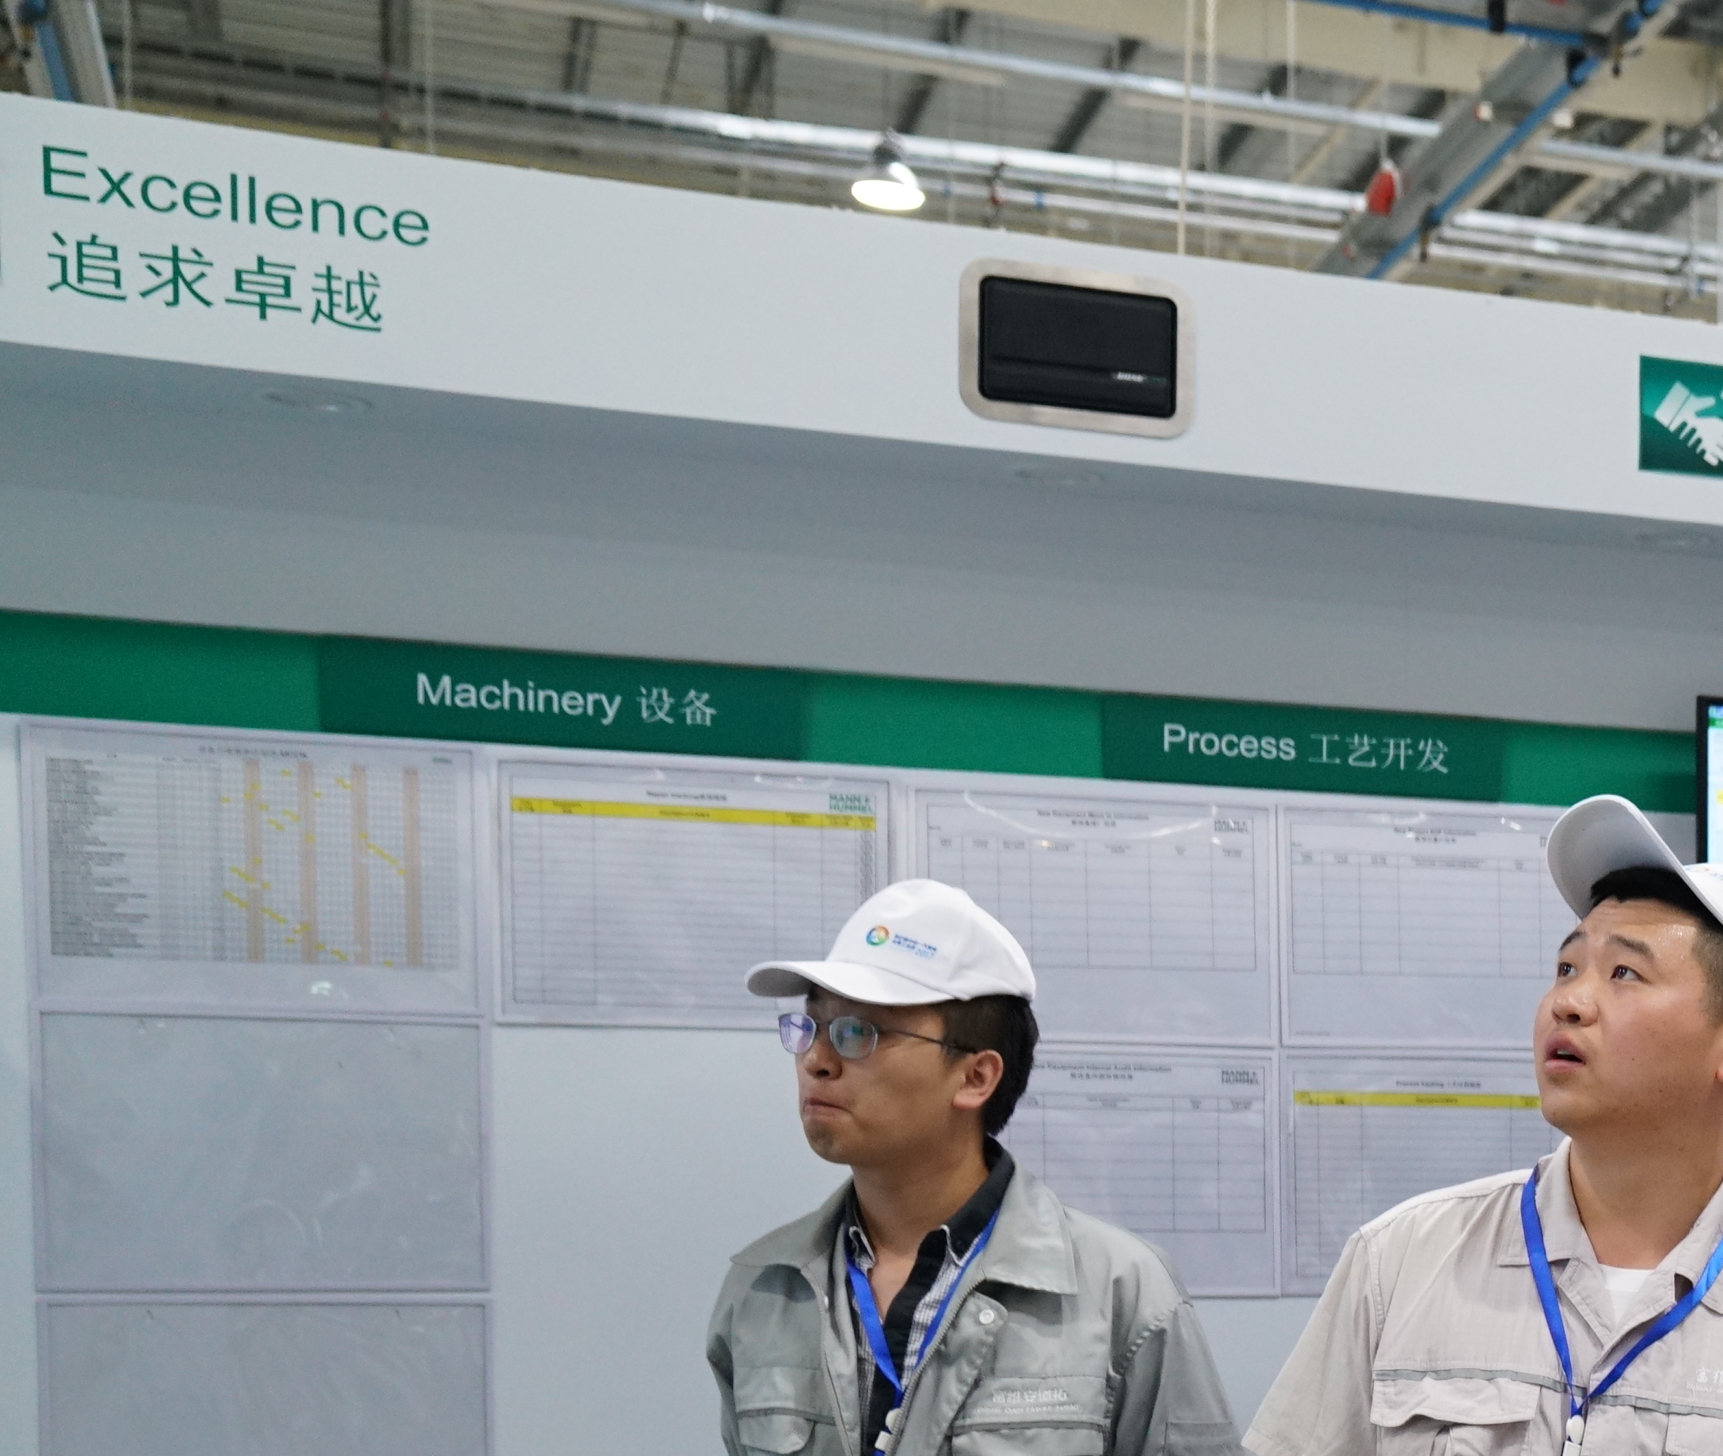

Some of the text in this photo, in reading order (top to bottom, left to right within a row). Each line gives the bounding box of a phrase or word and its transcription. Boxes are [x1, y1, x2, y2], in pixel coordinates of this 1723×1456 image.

[42, 144, 431, 248] Excellence
[46, 231, 384, 334] 追求卓越
[416, 673, 718, 728] Machinery 设备
[1163, 722, 1449, 775] Process 工艺开发
